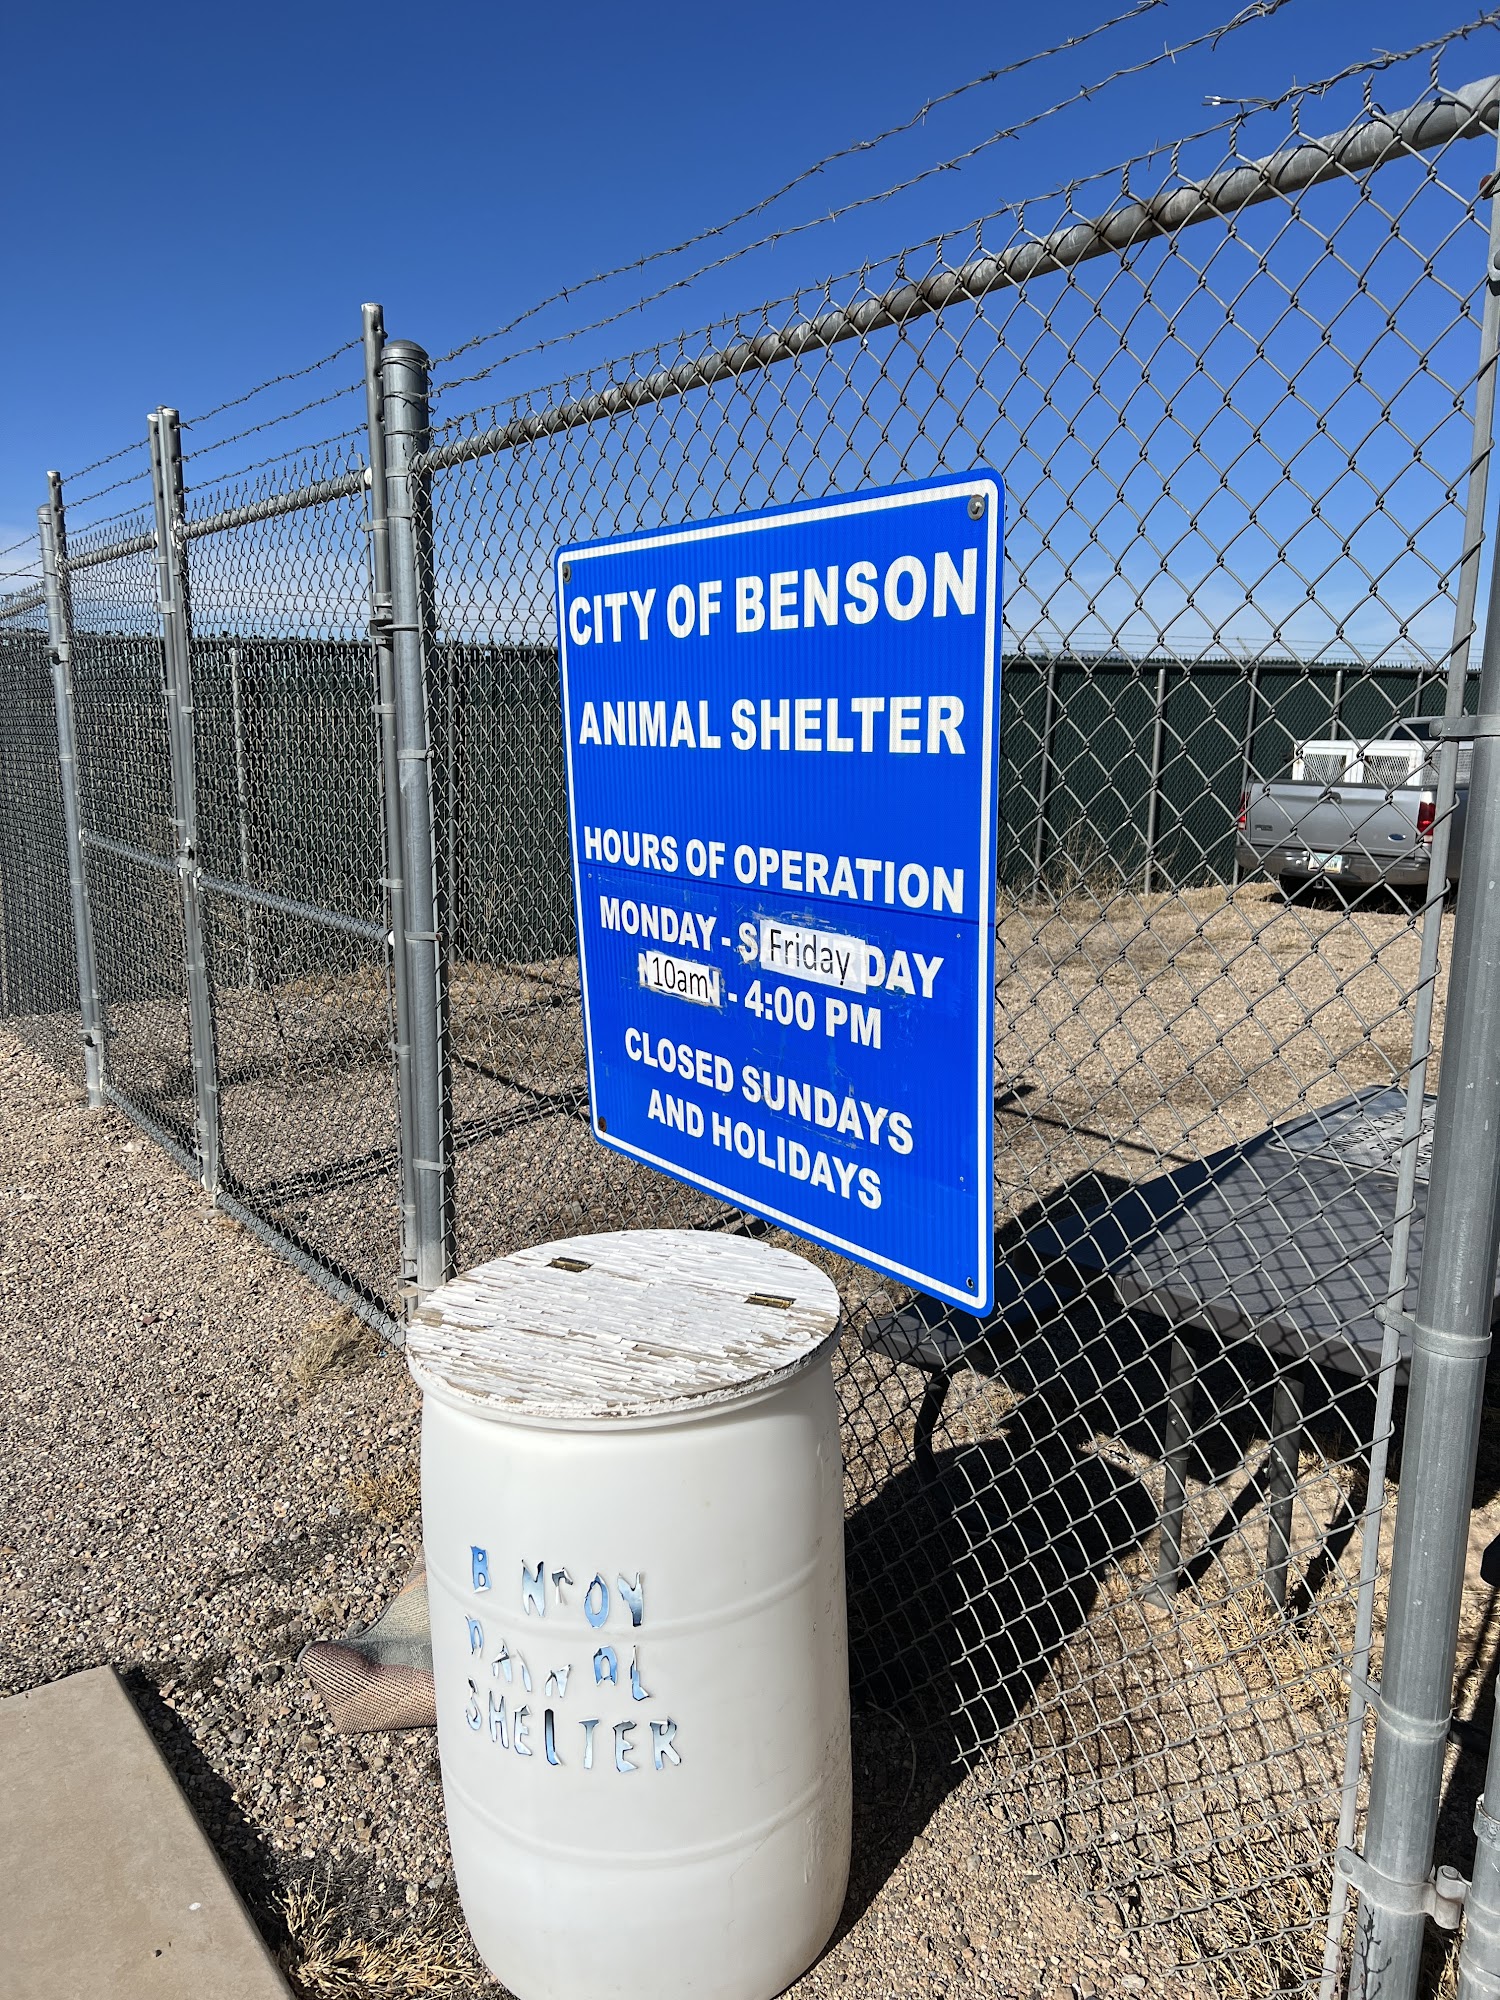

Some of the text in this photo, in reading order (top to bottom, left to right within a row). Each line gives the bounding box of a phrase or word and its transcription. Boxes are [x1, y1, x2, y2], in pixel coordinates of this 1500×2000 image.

[569, 547, 978, 646] CITY OF BENSON
[579, 695, 966, 755] ANIMAL SHELTER
[584, 825, 964, 914] HOURS OF OPERATION
[599, 895, 717, 952] MONDAY
[769, 928, 850, 986] Friday
[652, 956, 709, 999] 10am
[744, 979, 816, 1031] 4:00
[825, 997, 881, 1050] PM
[625, 1027, 914, 1155] CLOSED SUNDAYS
[647, 1088, 882, 1210] AND HOLIDAYS
